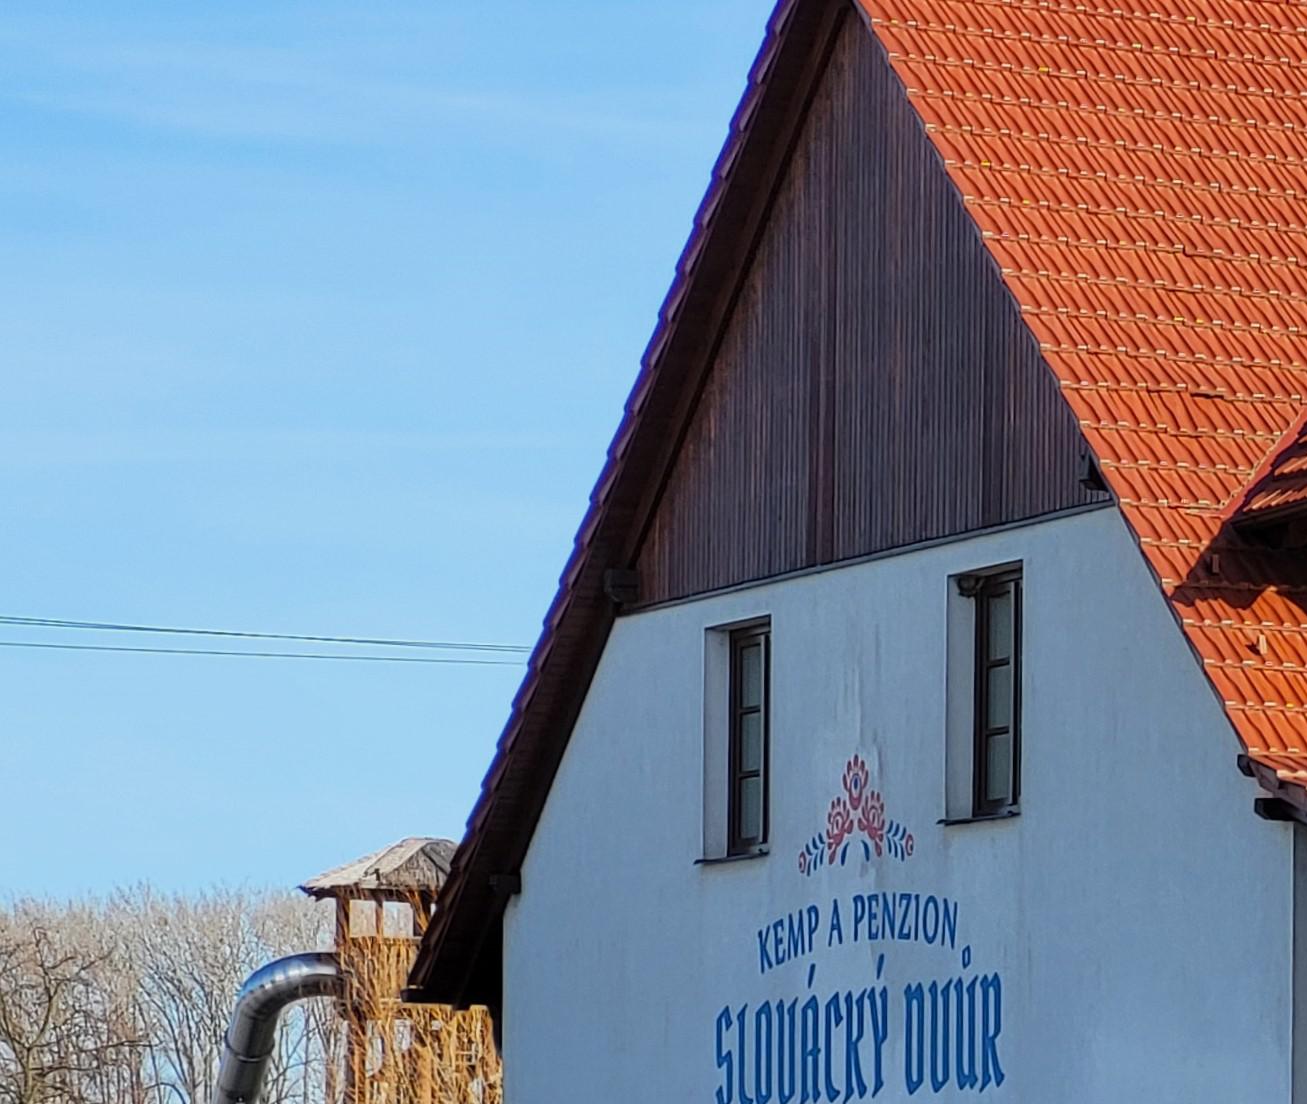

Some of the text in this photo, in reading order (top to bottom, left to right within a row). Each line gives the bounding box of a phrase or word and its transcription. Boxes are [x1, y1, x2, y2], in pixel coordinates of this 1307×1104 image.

[757, 892, 958, 974] KEMP A PENZION
[904, 944, 1005, 1096] DVŮR
